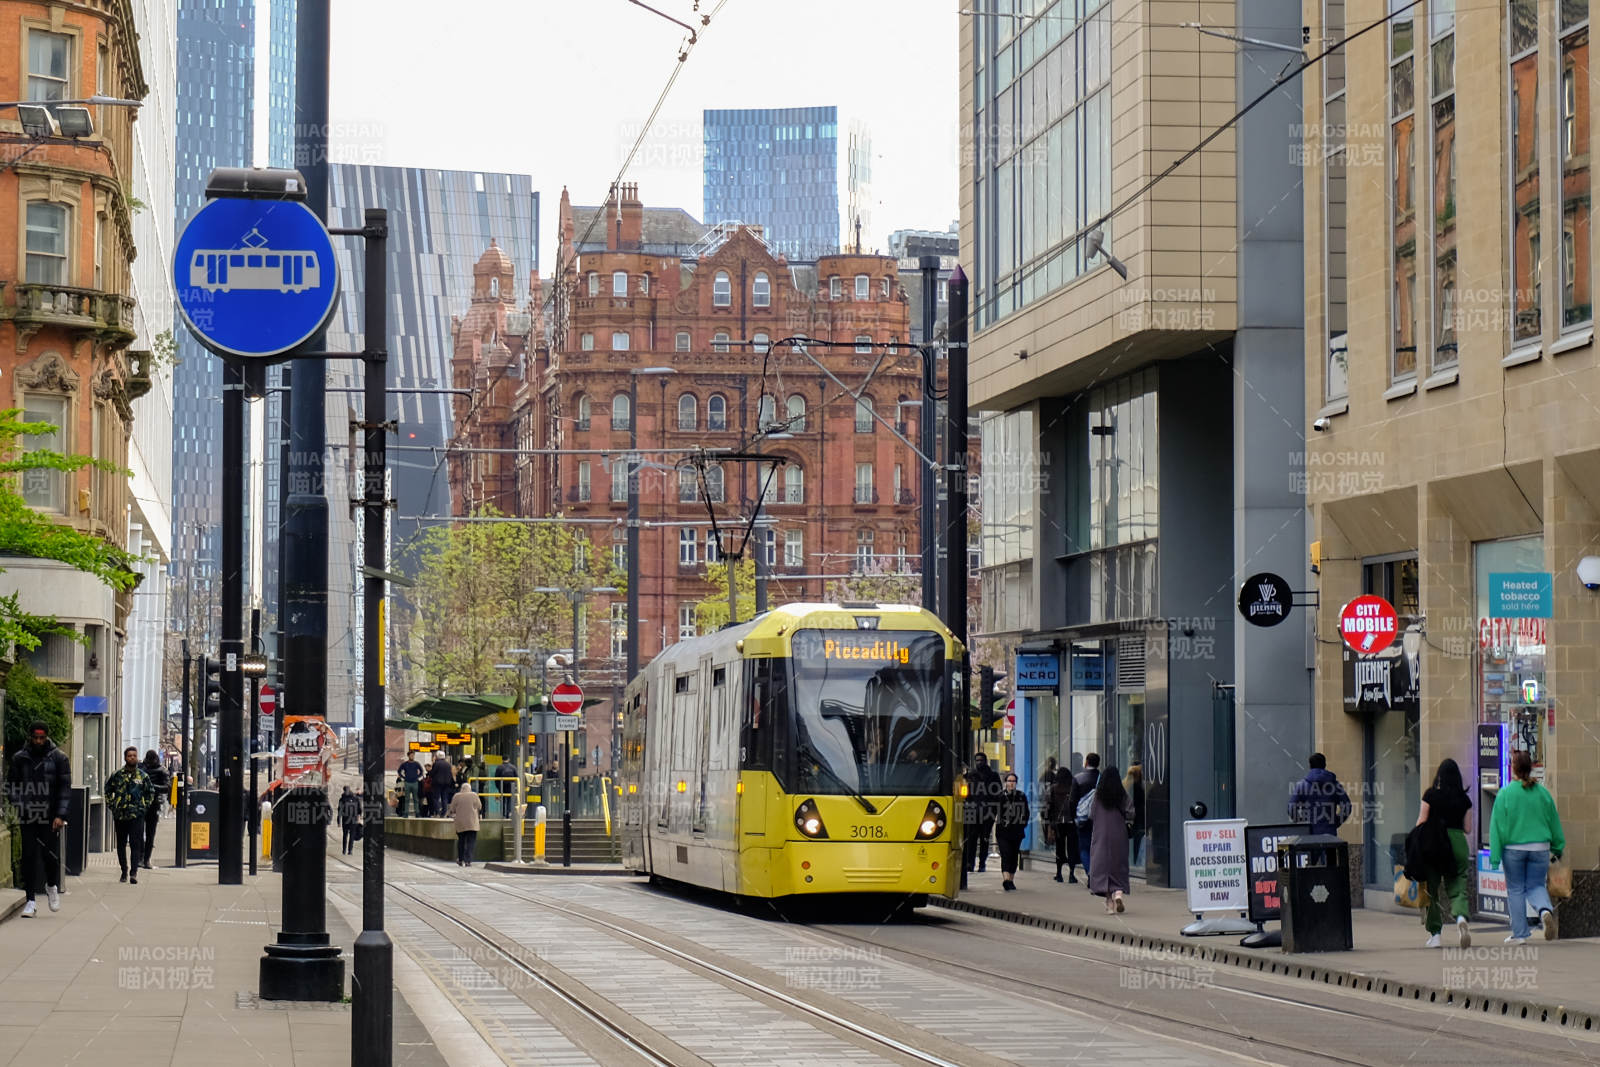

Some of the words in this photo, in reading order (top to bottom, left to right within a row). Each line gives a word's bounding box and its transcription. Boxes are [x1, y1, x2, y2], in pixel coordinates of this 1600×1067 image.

[1503, 581, 1537, 589] Heated
[1500, 592, 1540, 601] tobacco
[1356, 604, 1380, 616] CITY
[1502, 602, 1519, 610] sold
[1521, 602, 1540, 610] here
[1344, 617, 1394, 632] MOBILE
[1480, 618, 1513, 648] CITY
[825, 639, 909, 663] Piccadilly
[1019, 671, 1056, 680] NERO
[1196, 830, 1213, 840] BUY
[1219, 829, 1237, 839] SELL
[1203, 842, 1232, 852] REPAIR
[1190, 854, 1246, 866] ACCESSORIES
[1195, 868, 1216, 878] PRINT
[1223, 867, 1242, 876] COPY
[1198, 879, 1240, 889] SOUVENIRS
[1255, 880, 1277, 894] BUY
[1210, 892, 1230, 901] RAW
